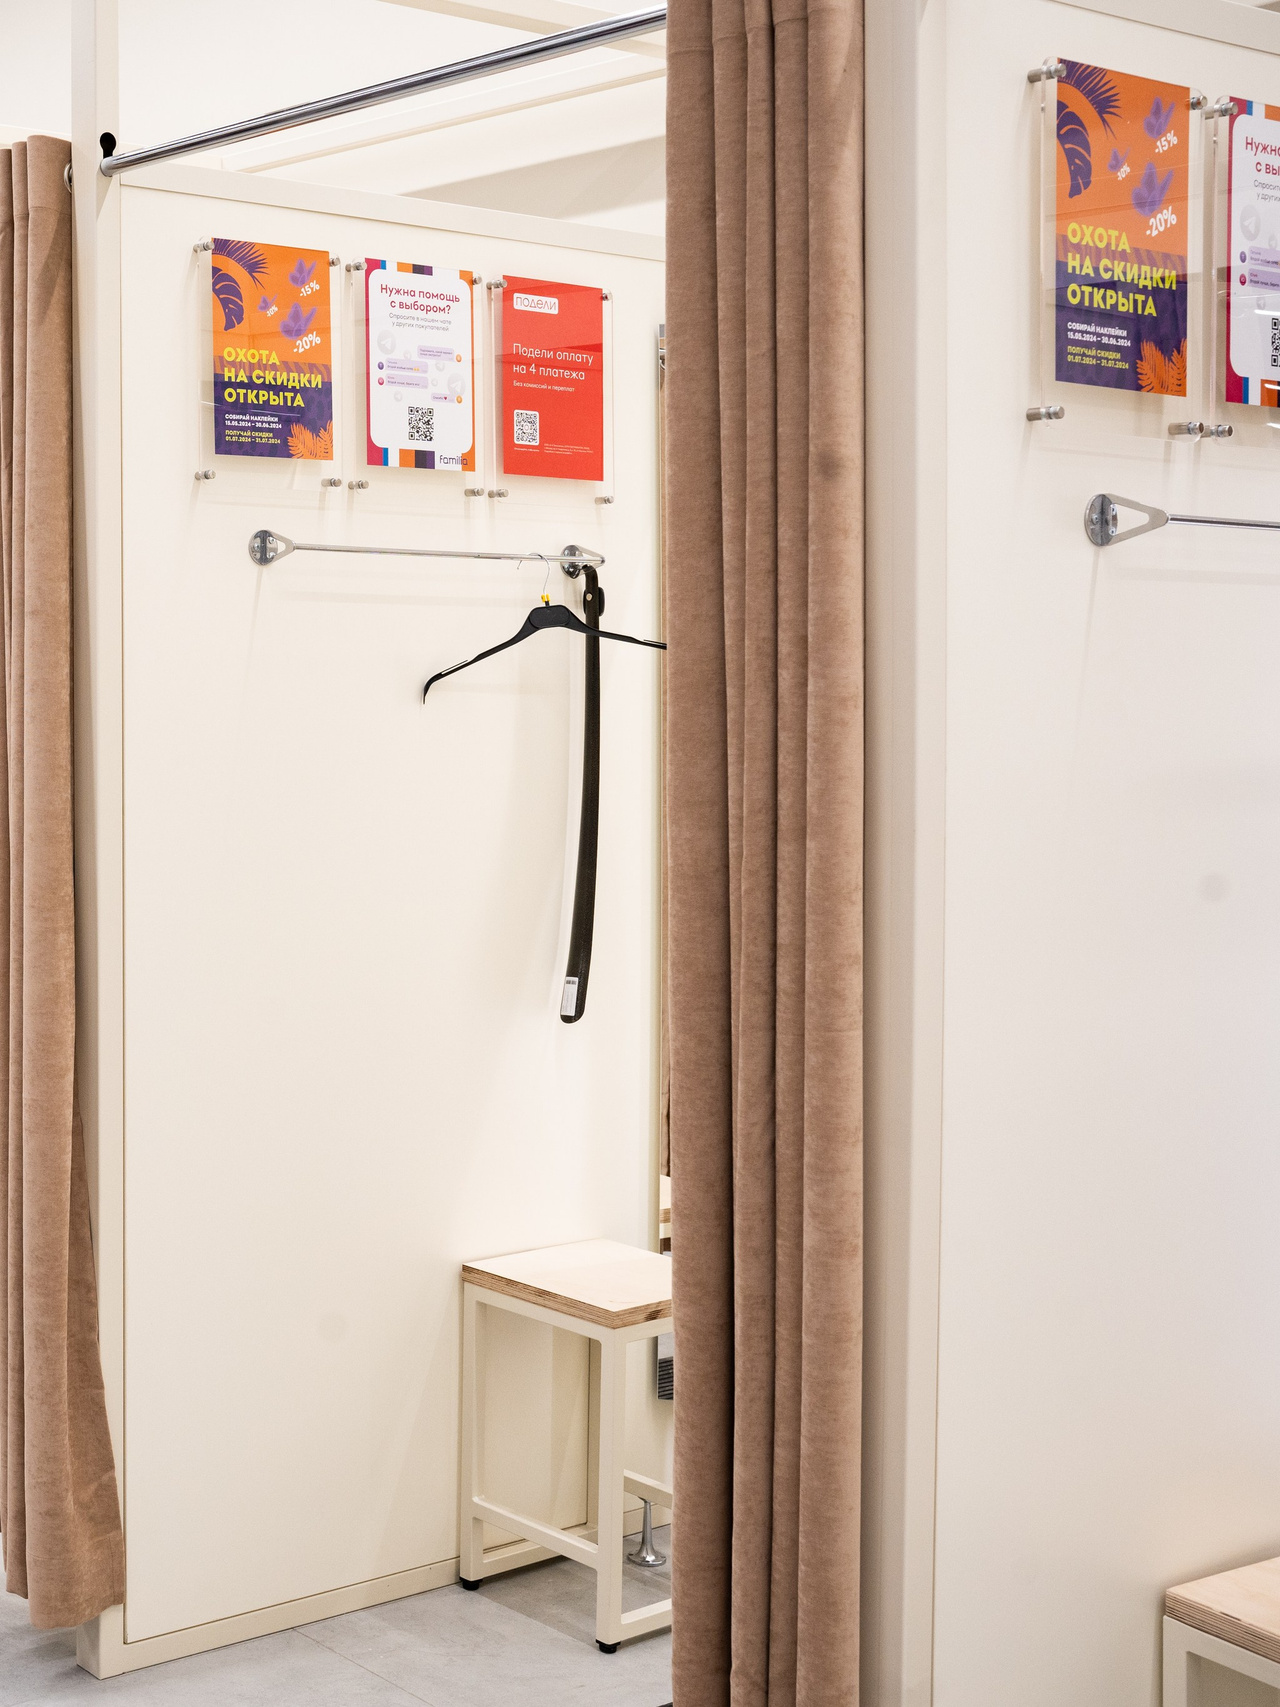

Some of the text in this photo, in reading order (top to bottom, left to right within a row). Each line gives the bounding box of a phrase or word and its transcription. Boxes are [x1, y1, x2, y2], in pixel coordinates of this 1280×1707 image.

[1155, 130, 1178, 153] -15%
[1117, 163, 1131, 180] -10%
[1255, 161, 1262, 173] с
[1253, 179, 1280, 192] Спросит
[1146, 205, 1177, 237] -20%
[1067, 222, 1131, 253] ОХОТА
[1067, 252, 1177, 290] НА СКИДКИ
[300, 280, 320, 297] -15%
[380, 283, 460, 303] Нужна помощь
[390, 300, 451, 314] с выбором?
[1067, 283, 1157, 317] ОТКРЫТА
[266, 305, 278, 317] -10%
[389, 312, 415, 321] Спросите
[415, 323, 449, 332] покупателей
[1067, 321, 1127, 337] СОБИРАЙ НАКЛЕЙКИ
[293, 331, 321, 354] -20%
[1067, 331, 1097, 342] 15.05.2024
[1101, 335, 1131, 347] 30.06.2024
[223, 347, 280, 365] ОХОТА
[513, 343, 593, 366] Подели оплату
[1067, 345, 1121, 360] ПОЛУЧАЙ СКИДКИ
[1067, 355, 1096, 365] 01.07.2024
[1101, 359, 1129, 369] 31.07.2024
[224, 367, 322, 389] НА СКИДКИ
[513, 363, 585, 380] на 4 платежа
[524, 382, 547, 390] комиссий
[552, 385, 575, 393] переплат
[224, 388, 305, 407] ОТКРЫТА
[225, 413, 250, 421] СОБИРАЙ
[439, 455, 468, 466] familia
